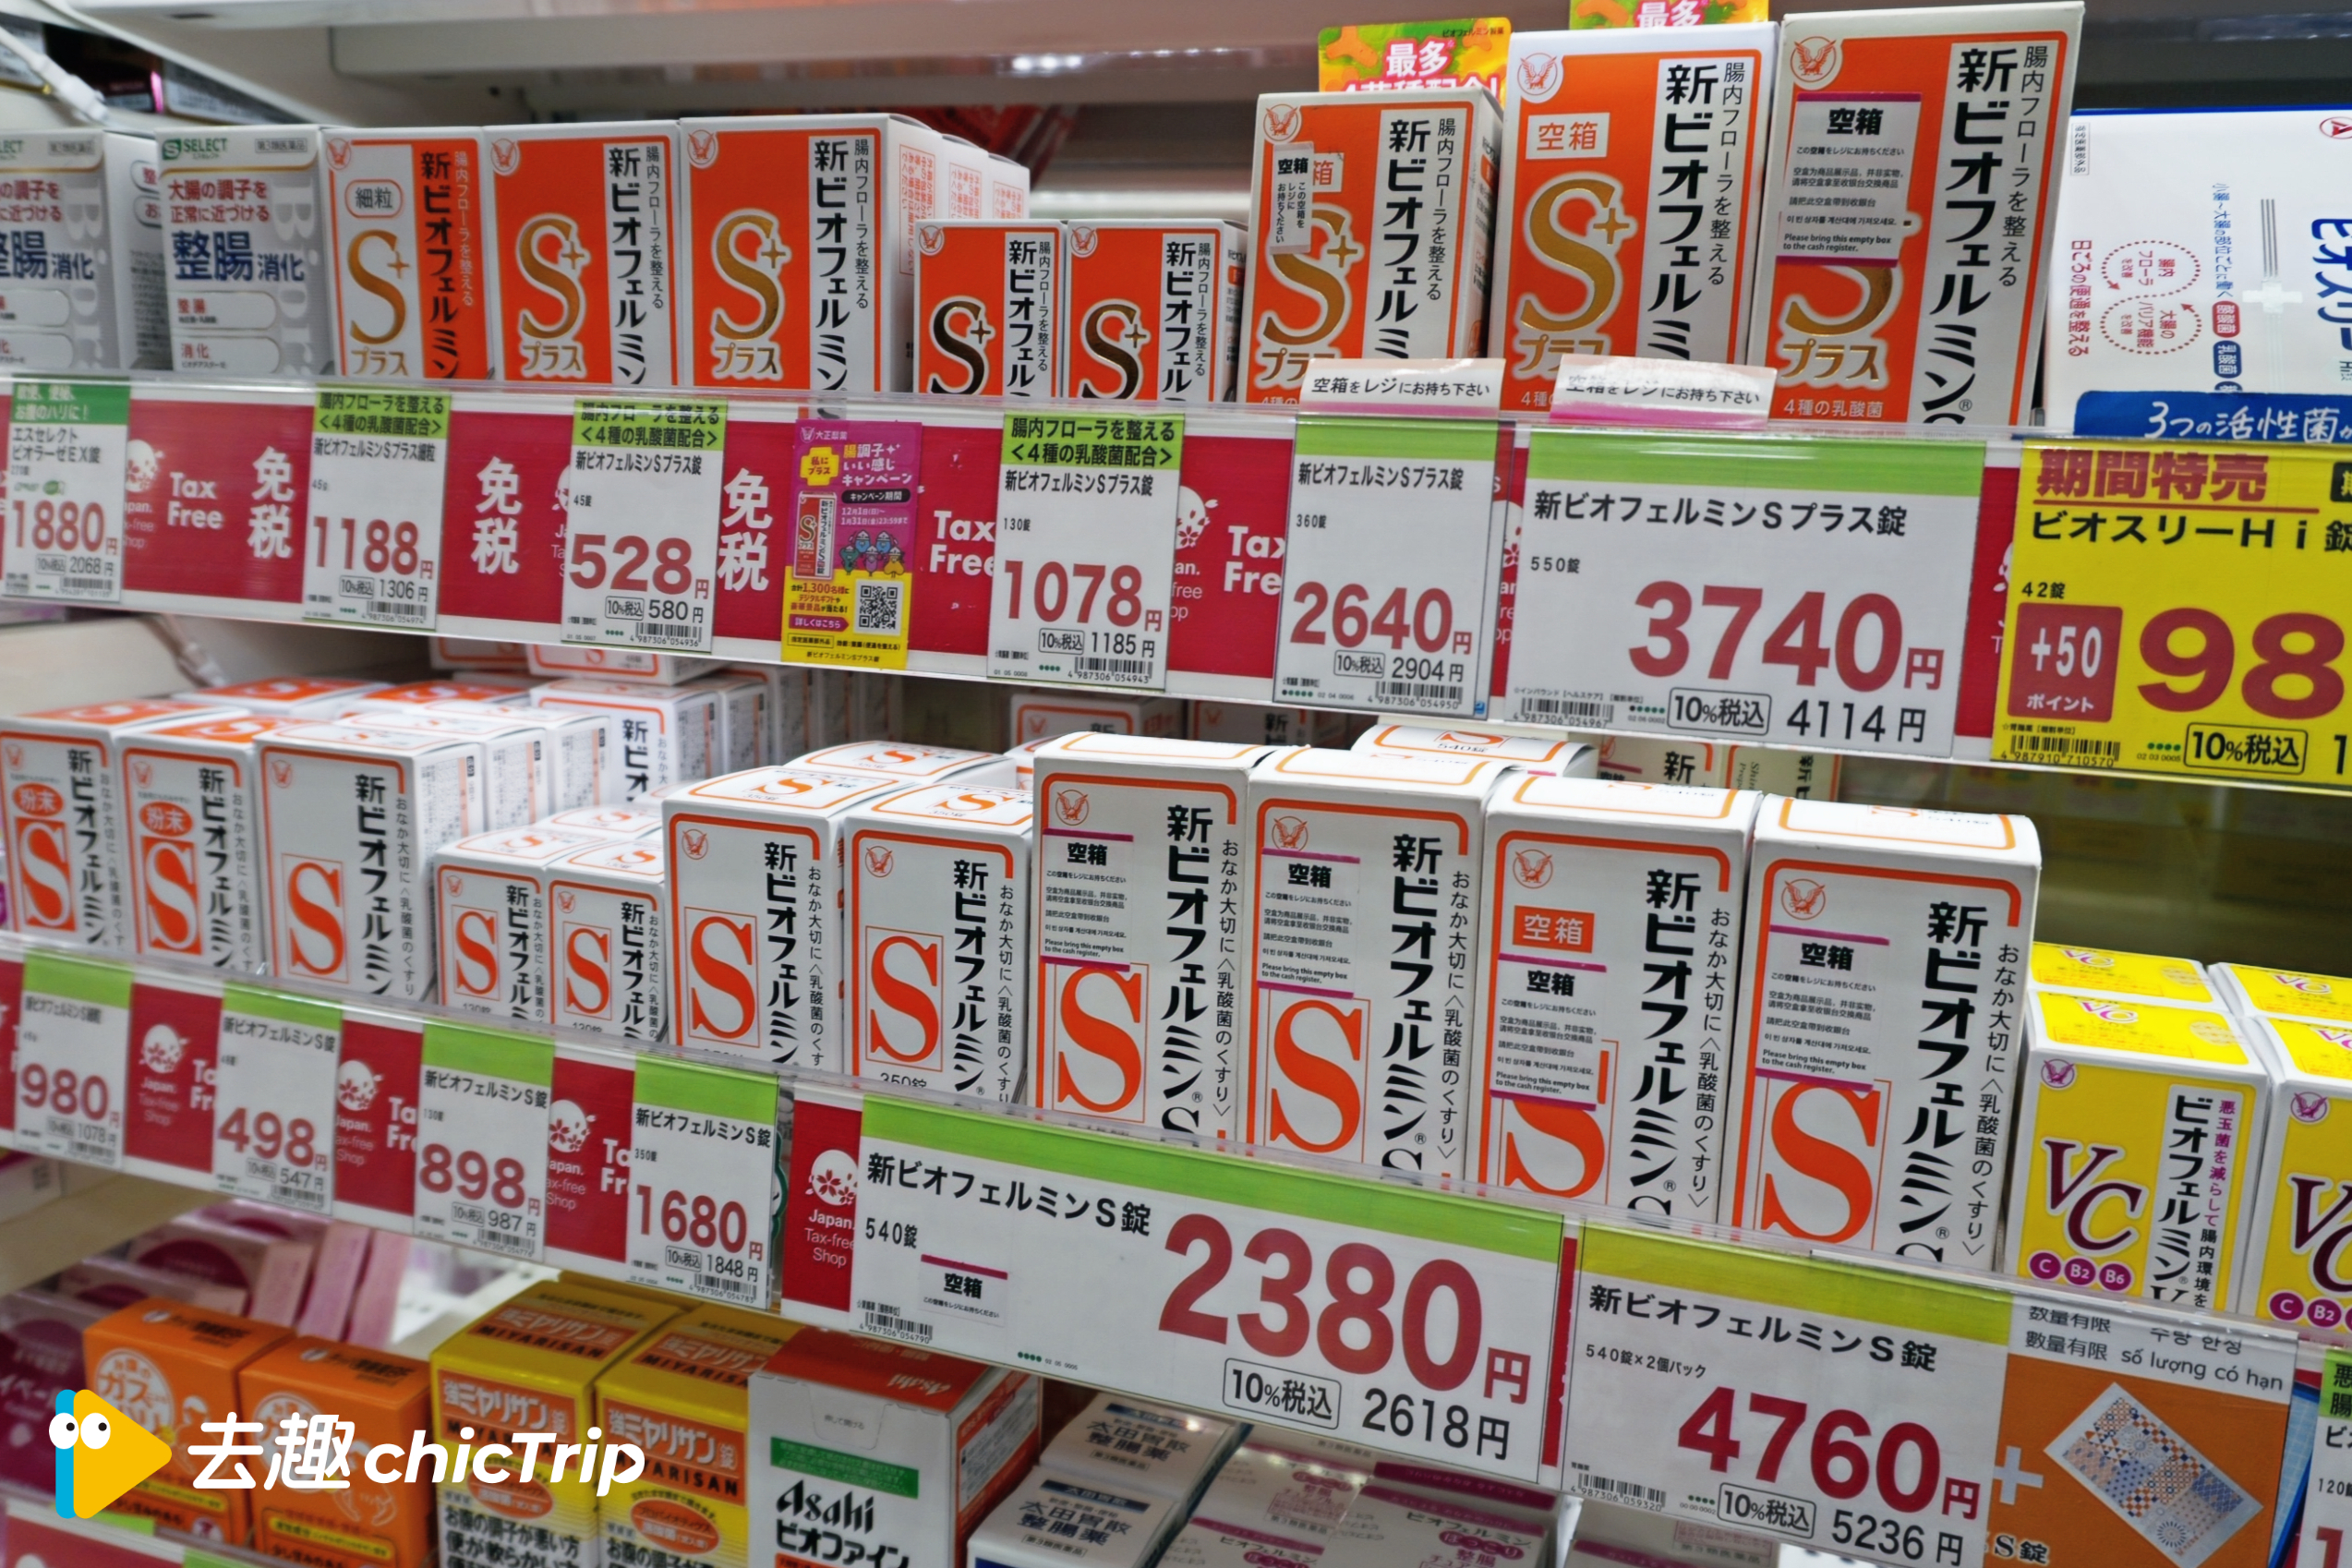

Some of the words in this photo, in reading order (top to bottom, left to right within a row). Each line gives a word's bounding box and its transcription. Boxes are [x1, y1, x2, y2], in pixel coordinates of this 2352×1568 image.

[1387, 42, 1449, 78] 最多
[1537, 121, 1598, 152] 空箱
[1827, 108, 1884, 136] 空箱
[183, 139, 227, 152] SELECT
[1796, 146, 1904, 156] この空箱をレジにお持ちください
[1277, 157, 1309, 175] 空箱
[1707, 62, 1746, 286] 腸内フローラを整える
[1999, 45, 2048, 287] 腸内フローラを整える
[168, 179, 267, 200] 大腸の調子を
[355, 187, 393, 211] 細粒
[1287, 183, 1296, 210] レジに
[171, 205, 271, 223] 正常に近づける
[1275, 183, 1286, 243] お持ちください
[1297, 182, 1306, 228] この空箱を
[1425, 118, 1456, 300] 腸内フローラを整える
[453, 151, 476, 308] 腸内フローラを整える
[645, 146, 664, 310] 腸内フローラを整える
[853, 139, 870, 310] 腸内フローラを整える
[1784, 233, 1809, 242] Please
[1810, 234, 1831, 244] bring
[1833, 234, 1847, 242] this
[1849, 235, 1874, 246] empty
[1807, 243, 1824, 251] cash
[1826, 244, 1859, 253] register.
[171, 230, 252, 282] 整腸
[257, 253, 305, 282] 消化
[2138, 250, 2153, 286] フローラ
[1037, 240, 1051, 371] 腸内フローラを整える
[1194, 242, 1212, 377] 腸内フローラを整える
[2067, 239, 2093, 357] 日ごろの便通を整える
[521, 344, 583, 373] プラス
[1781, 343, 1882, 382] プラス
[1311, 376, 1490, 399] 空箱をレジにお持ち下さい
[319, 392, 444, 415] 腸内フローラを整える
[581, 402, 720, 426] 腸内フローラを整える
[1783, 399, 1883, 419] 4種の乳酸菌
[13, 428, 78, 443] エスセレクト
[1011, 416, 1176, 442] 腸内フローラを整える
[313, 438, 436, 462] 新ビオフェルミンSプラス細粒
[575, 451, 703, 476] 新ビオフェルミンSプラス錠
[811, 457, 829, 465] 私に
[808, 466, 830, 476] プラス
[843, 458, 896, 472] いい感じ
[1297, 462, 1464, 492] 新ビオフェルミンSプラス錠
[2036, 448, 2270, 502] 期間特売
[169, 471, 217, 501] Tax
[312, 479, 329, 491] 45g
[842, 473, 912, 487] キャンペーン
[1005, 469, 1154, 497] 新ビオフェルミンSプラス錠
[247, 445, 296, 560] 免税
[573, 494, 592, 508] 45錠
[850, 491, 902, 501] キャンペーン期間
[167, 501, 224, 530] Free
[470, 456, 523, 574] 免税
[933, 510, 996, 543] Tax
[1003, 517, 1031, 532] 130錠
[1296, 513, 1327, 530] 360錠
[1534, 488, 1909, 537] 新ビオフェルミンSプラス錠
[718, 467, 774, 593] 免税
[1529, 555, 1581, 575] 550錠
[2020, 581, 2067, 600] 42錠
[607, 597, 644, 620] 10%税込
[795, 617, 841, 628] 詳しくはこちら
[1040, 630, 1083, 652] 10%税込
[2031, 624, 2103, 680] +50
[1077, 670, 1111, 682] 987306
[1115, 672, 1151, 684] 054943
[1672, 694, 1765, 730] 10%税込
[2026, 693, 2094, 714] ポイント
[2013, 750, 2060, 765] 987910
[2067, 754, 2115, 767] 710570
[2191, 730, 2301, 767] 10%税込
[18, 788, 58, 813] 粉末
[145, 807, 187, 833] 粉末
[66, 748, 106, 945] 新ビオフェルミン
[1067, 842, 1107, 866] 空箱
[199, 767, 235, 969] 新ビオフェルミン
[1288, 862, 1332, 889] 空箱
[355, 773, 394, 995] 新ビオフェルミン
[287, 861, 345, 976] S
[1522, 913, 1585, 947] 空箱
[1800, 942, 1854, 971] 空箱
[690, 915, 757, 1040] S
[1526, 970, 1575, 997] 空箱
[1771, 972, 1876, 992] この空箱をレジにお持ちください
[870, 935, 940, 1064] S
[223, 1016, 336, 1054] 新ビオフェルミンS錠
[1057, 966, 1143, 1114] S
[423, 1069, 548, 1110] 新ビオフェルミンS錠
[1270, 998, 1364, 1154] S
[635, 1107, 771, 1151] 新ビオフェルミンS錠
[1760, 1081, 1882, 1244] S
[867, 1152, 1152, 1238] 新ビオフェルミンS錠
[2044, 1139, 2144, 1252] VC
[808, 1212, 855, 1230] Japan.
[864, 1215, 918, 1250] 540錠
[813, 1247, 847, 1267] Shop
[2038, 1258, 2053, 1273] C
[2070, 1262, 2092, 1281] B2
[2105, 1267, 2126, 1285] B6
[942, 1272, 983, 1300] 空箱
[2028, 1305, 2112, 1334] 数量有限
[2280, 1298, 2294, 1314] C
[2313, 1305, 2335, 1322] B2
[477, 1324, 606, 1359] MIYARISAN
[1588, 1284, 1938, 1373] 新ビオフェルミンS錠
[2024, 1330, 2109, 1362] 數量有限
[2215, 1365, 2239, 1382] có
[2247, 1369, 2284, 1392] hạn
[1231, 1368, 1333, 1420] 10%税込
[1087, 1418, 1190, 1454] 太田胃散
[776, 1478, 874, 1536] Asahi
[1019, 1499, 1132, 1536] 太田胃散
[1723, 1489, 1811, 1532] 10%税込
